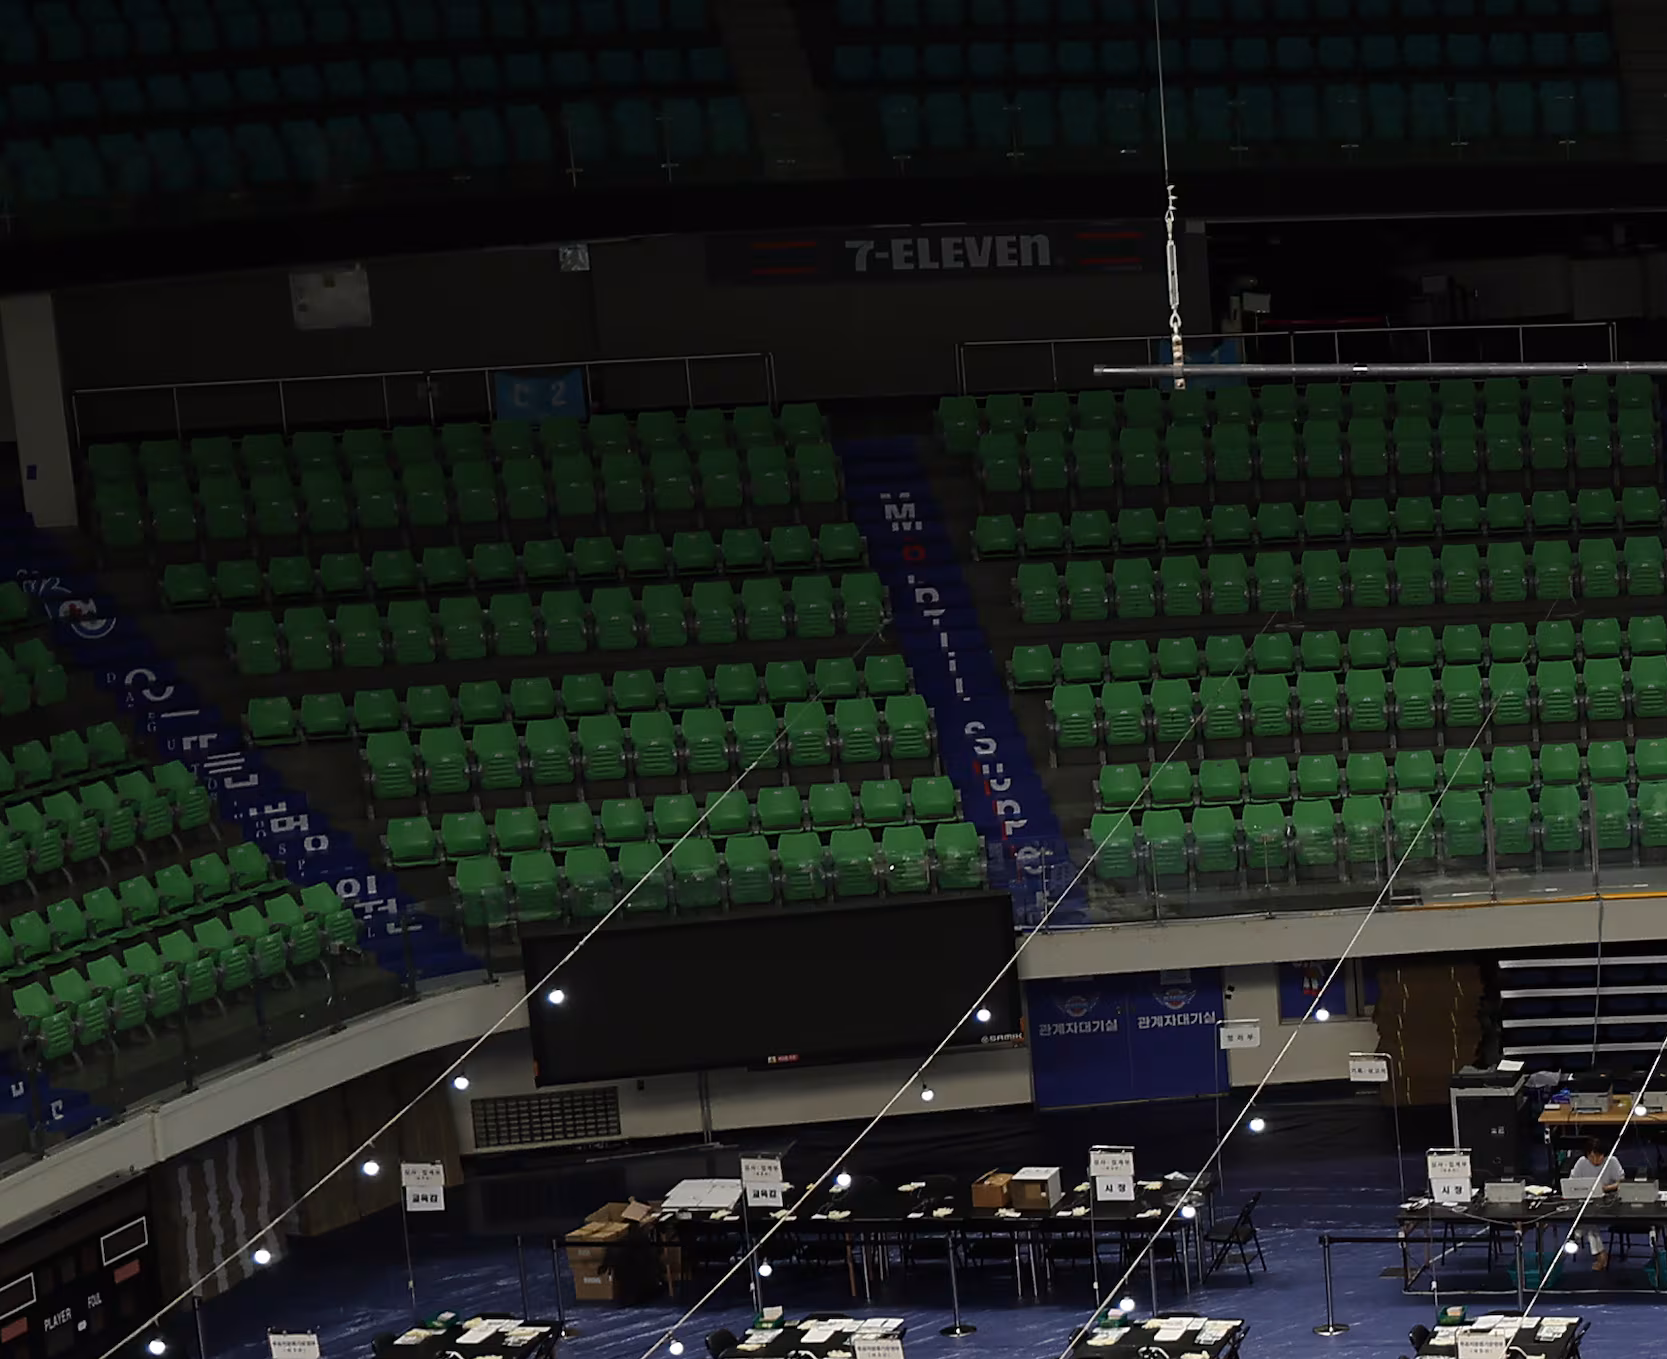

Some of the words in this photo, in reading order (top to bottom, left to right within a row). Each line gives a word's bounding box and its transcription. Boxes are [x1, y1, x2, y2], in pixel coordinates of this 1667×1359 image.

[1038, 1019, 1118, 1036] 관계자대기실
[1137, 1011, 1217, 1030] 관계자대기실
[44, 1307, 72, 1332] PLAYER
